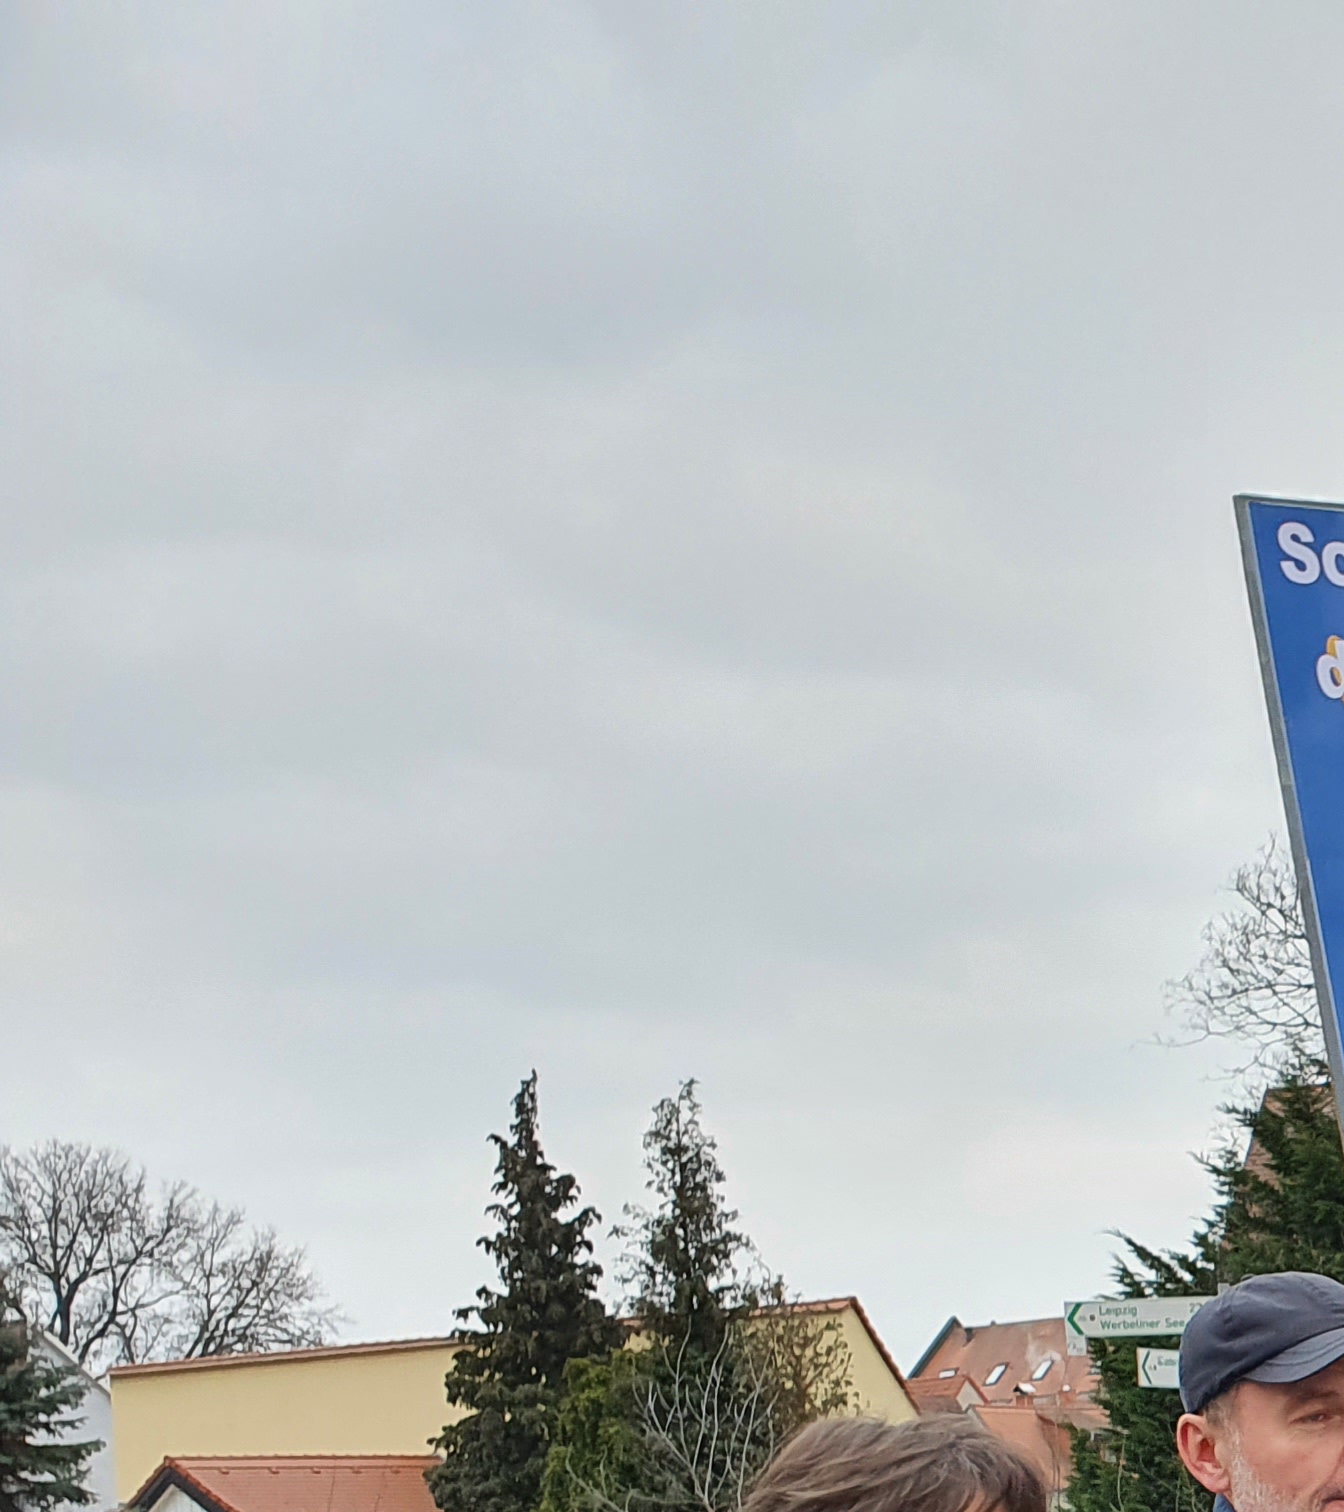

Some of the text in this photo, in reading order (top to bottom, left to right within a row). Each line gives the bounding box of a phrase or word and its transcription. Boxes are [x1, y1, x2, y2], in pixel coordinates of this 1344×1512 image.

[1099, 1304, 1138, 1317] Leipzig
[1100, 1317, 1185, 1331] Werbeliner See
